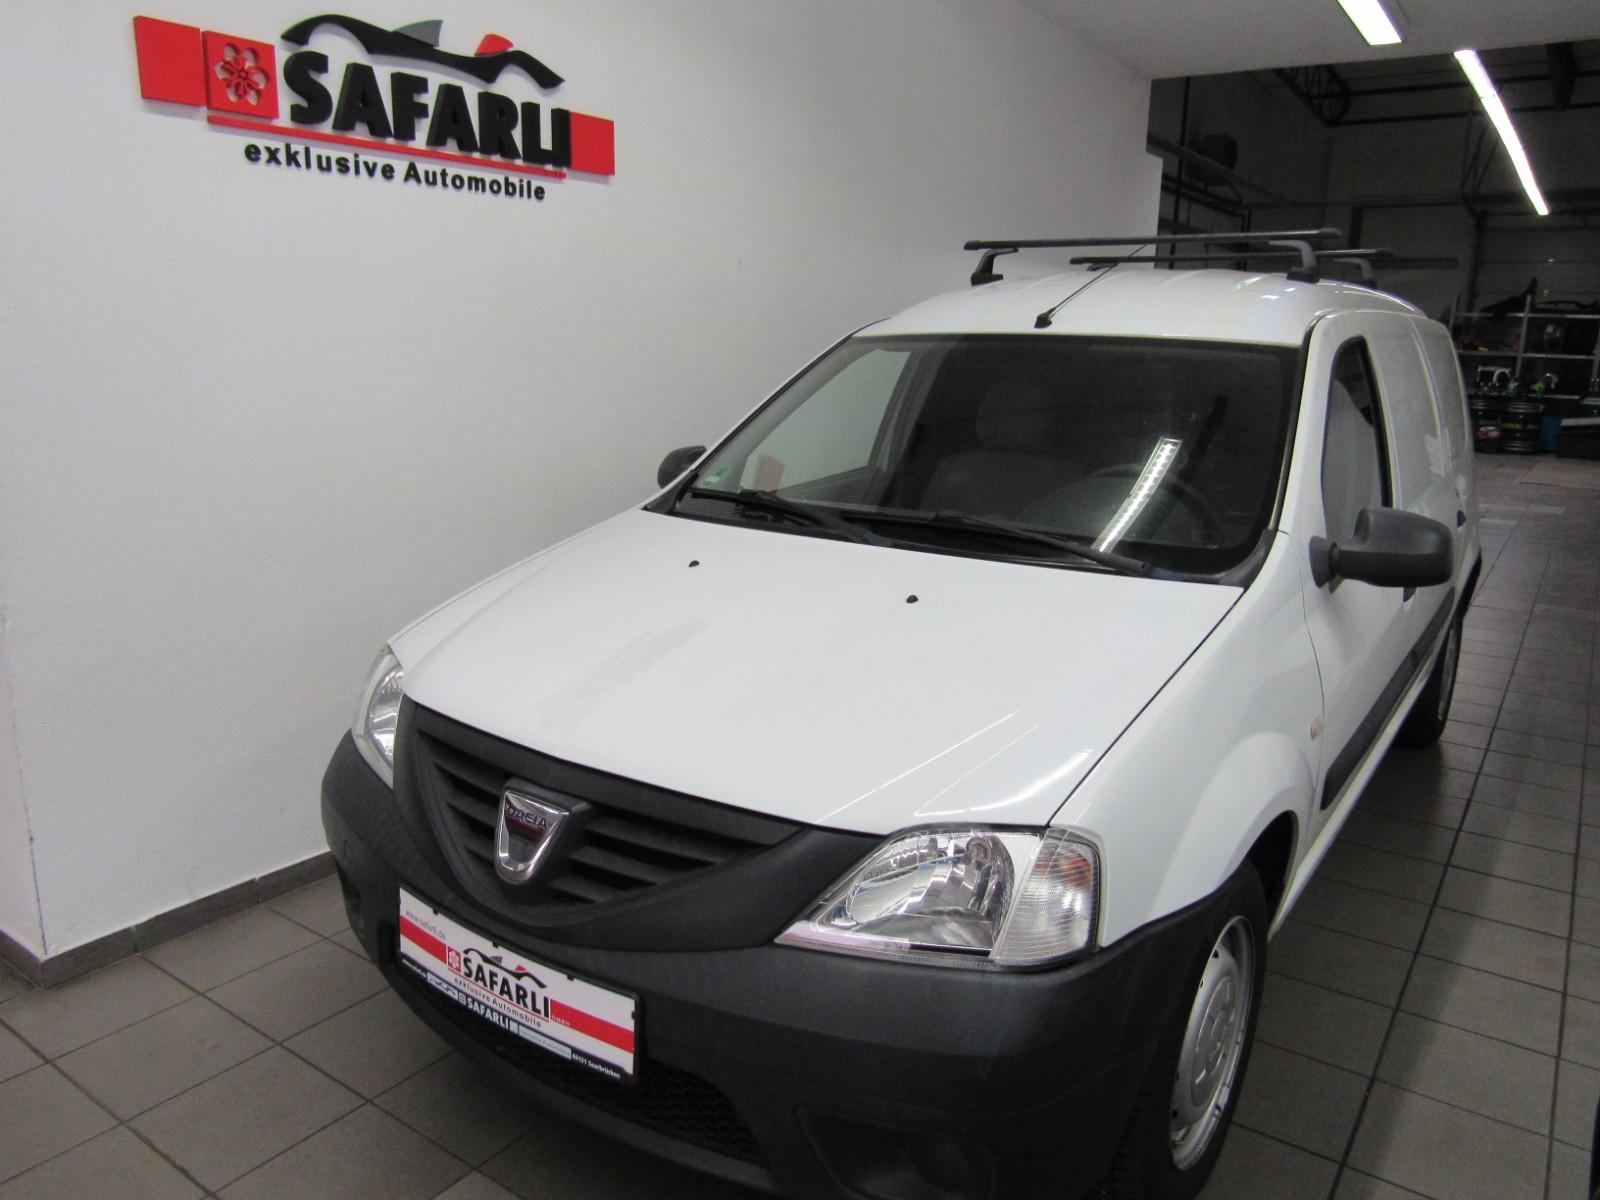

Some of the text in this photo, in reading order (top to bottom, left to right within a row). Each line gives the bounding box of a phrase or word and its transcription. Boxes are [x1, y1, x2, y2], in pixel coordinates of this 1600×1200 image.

[283, 51, 572, 167] SAFARLI
[245, 142, 545, 200] exklusive Automobile
[454, 977, 541, 1028] exklusive Automobile
[464, 956, 549, 1018] SAFARLI
[468, 997, 508, 1028] SAFARLI
